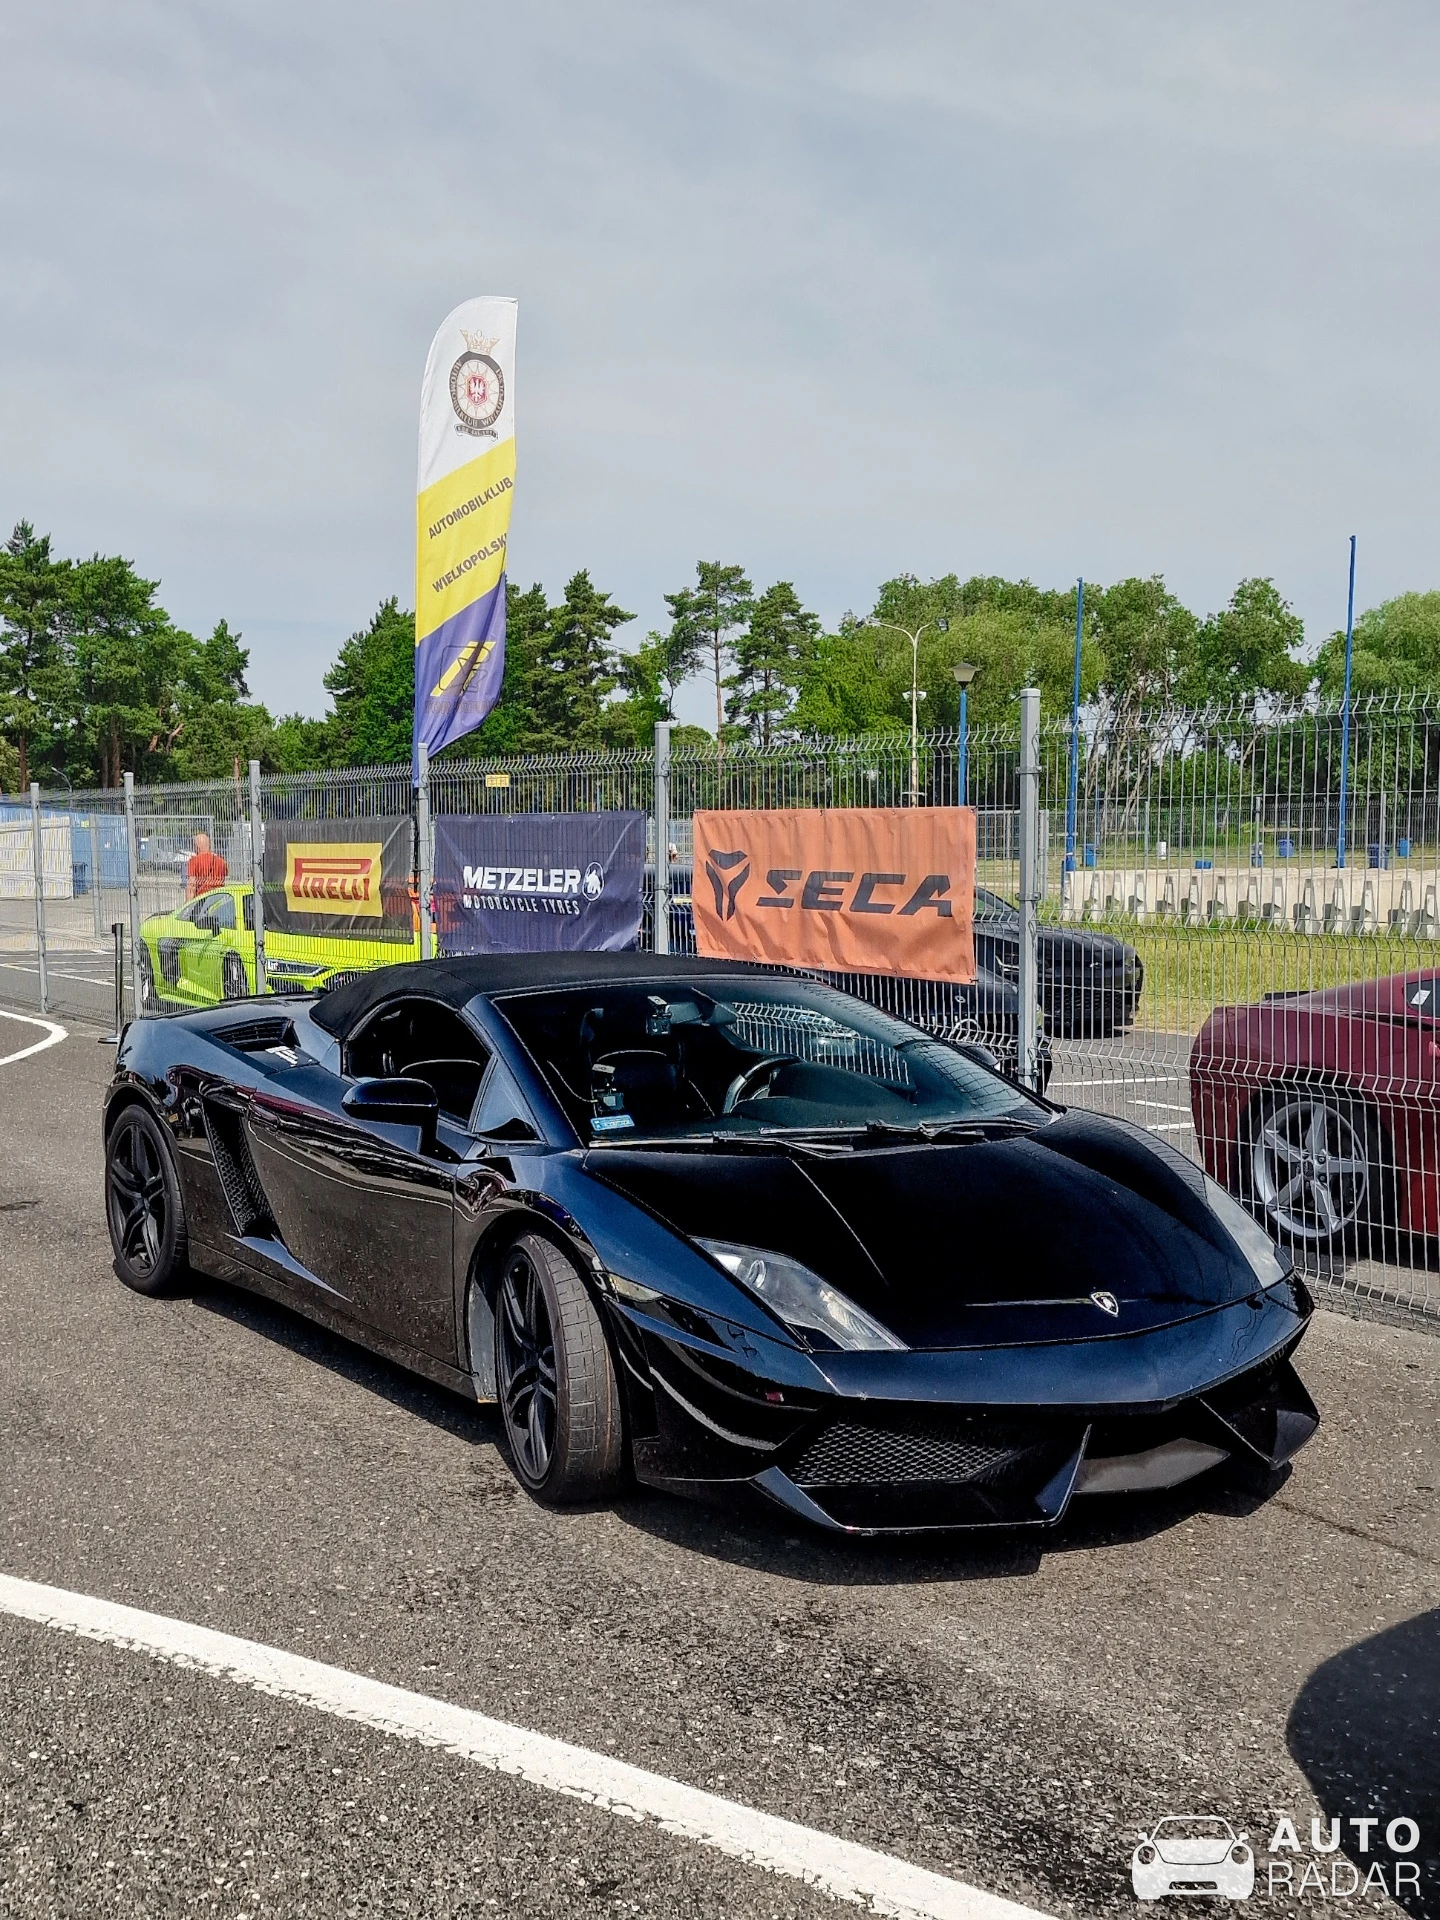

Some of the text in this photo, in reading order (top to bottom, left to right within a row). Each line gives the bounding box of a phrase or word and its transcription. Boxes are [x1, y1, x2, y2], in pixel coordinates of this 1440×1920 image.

[428, 477, 513, 539] AUTOMOBILKLUB
[292, 858, 372, 901] PIRELLI
[463, 866, 581, 893] METZELER
[756, 870, 953, 917] SECA
[463, 895, 580, 915] MOTORCYCLE TYRES
